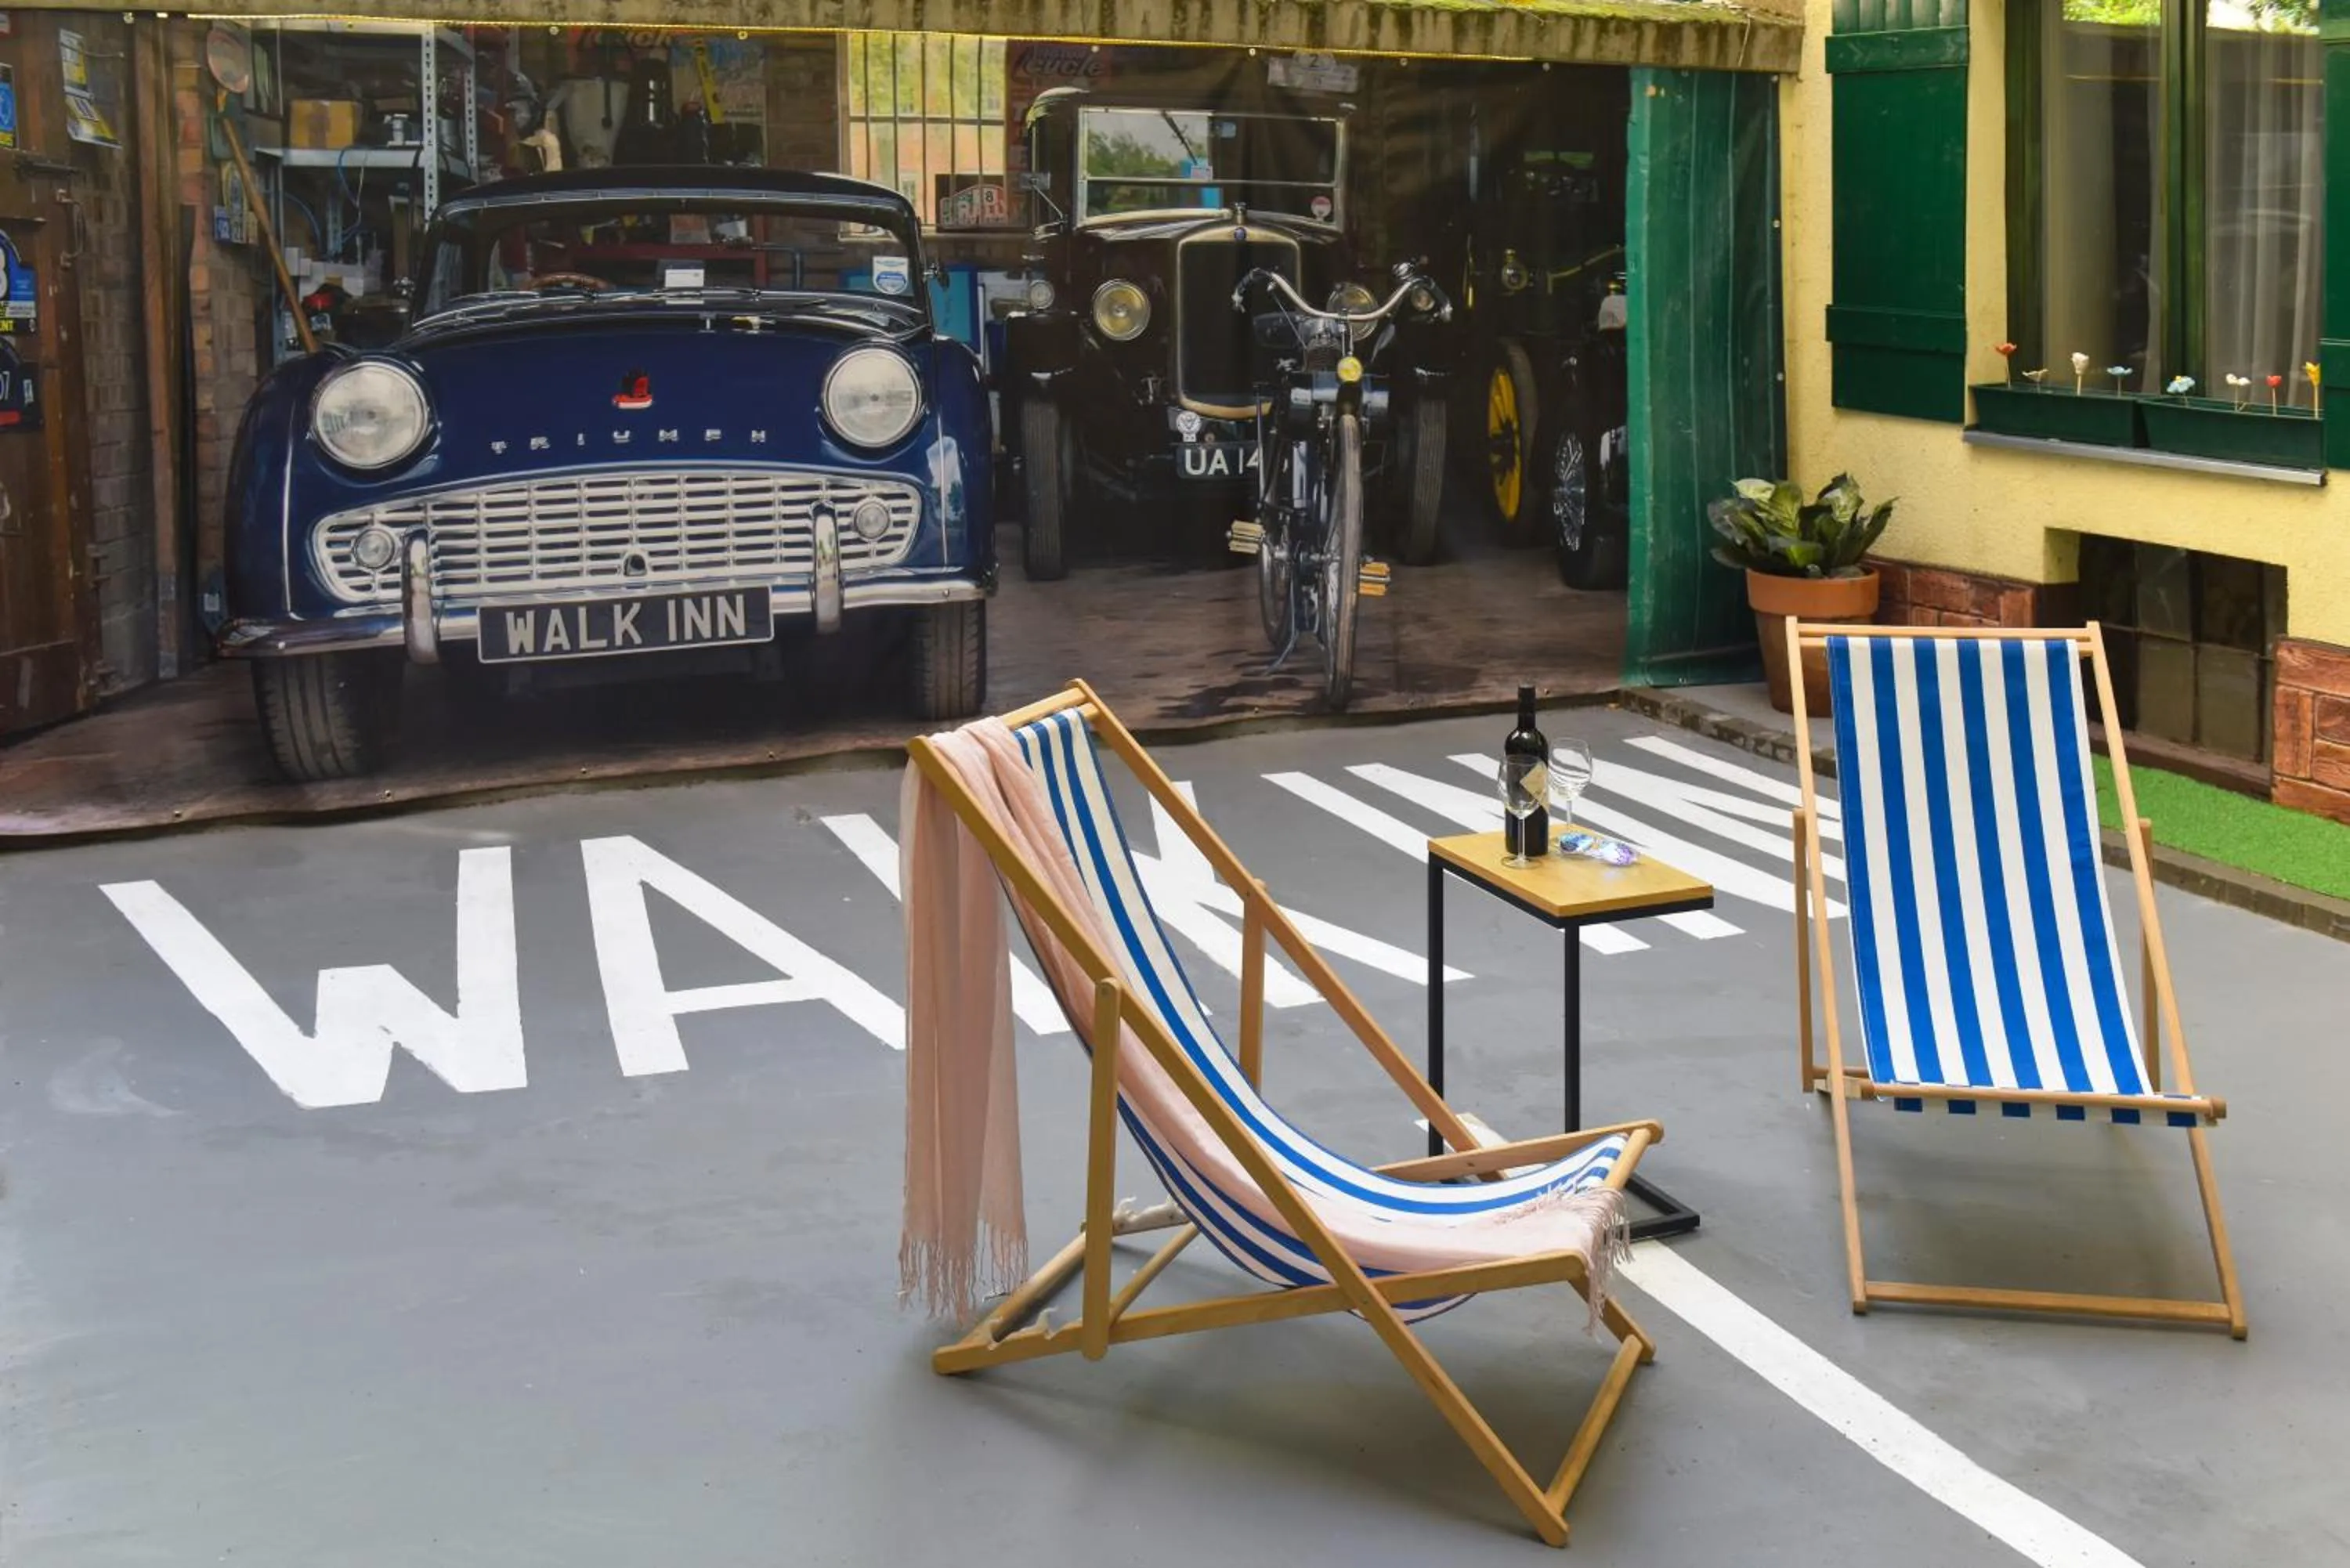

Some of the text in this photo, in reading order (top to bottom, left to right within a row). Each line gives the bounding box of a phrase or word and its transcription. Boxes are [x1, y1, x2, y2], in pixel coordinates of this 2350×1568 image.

[490, 428, 766, 454] TRIUMPH
[1184, 448, 1229, 476] UA
[505, 594, 746, 655] WALK INN
